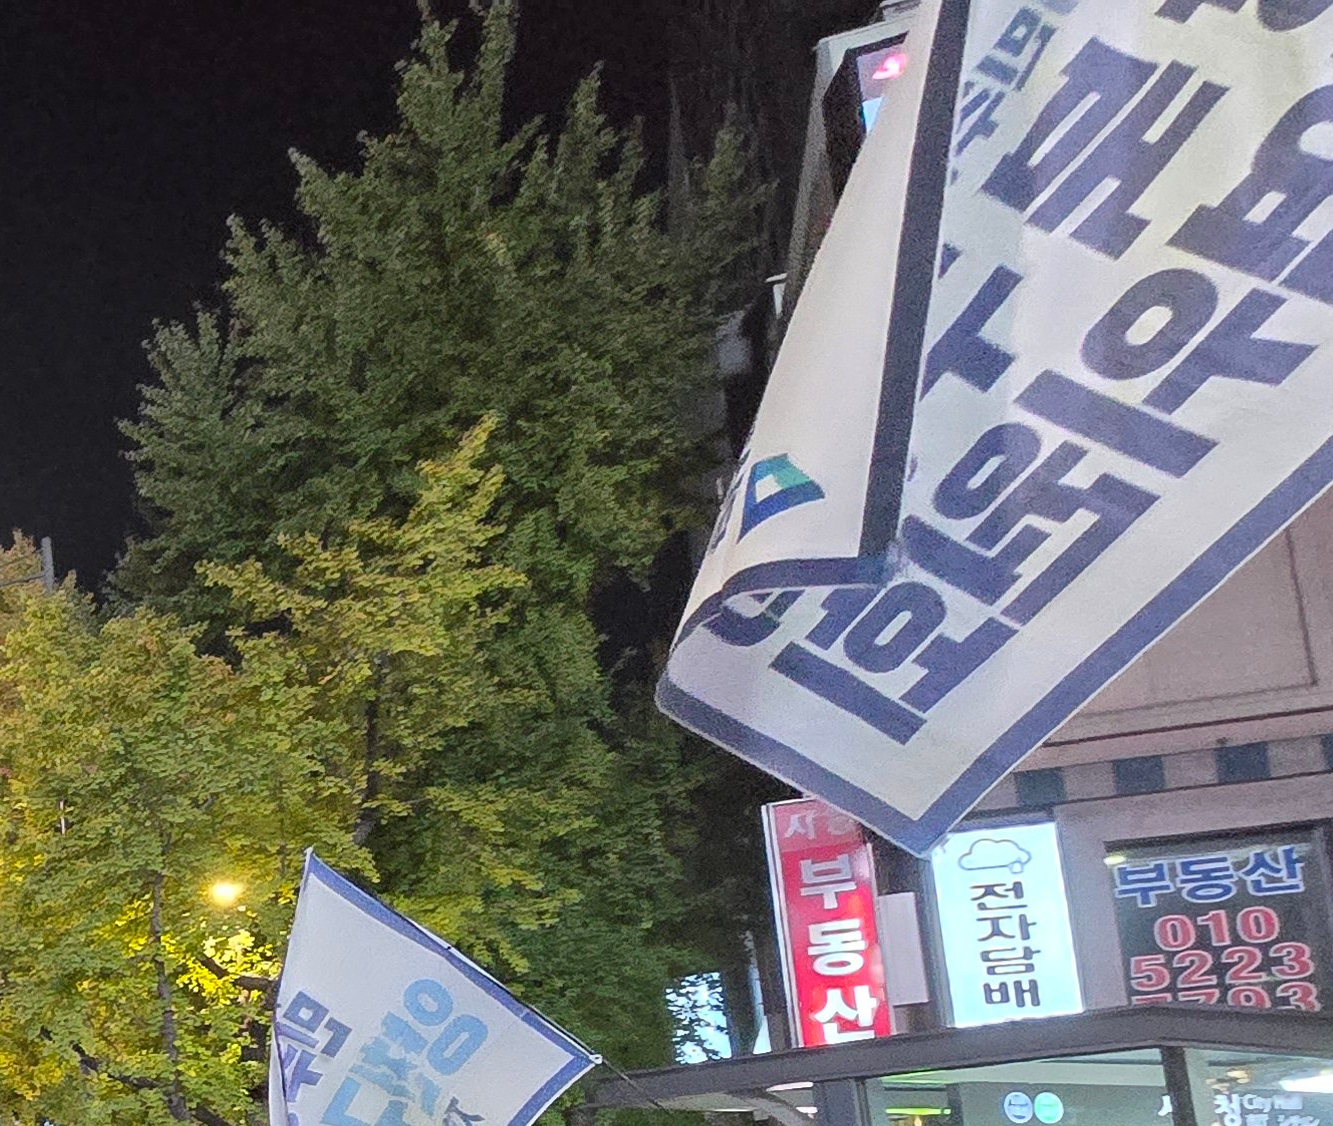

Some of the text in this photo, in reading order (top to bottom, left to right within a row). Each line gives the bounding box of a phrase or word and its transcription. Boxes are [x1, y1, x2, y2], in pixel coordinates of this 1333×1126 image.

[1114, 845, 1306, 908] 부동산
[800, 854, 878, 1045] 부동산
[969, 881, 1041, 1009] 전자담배
[1154, 906, 1280, 951] 010
[1130, 942, 1314, 991] 5223
